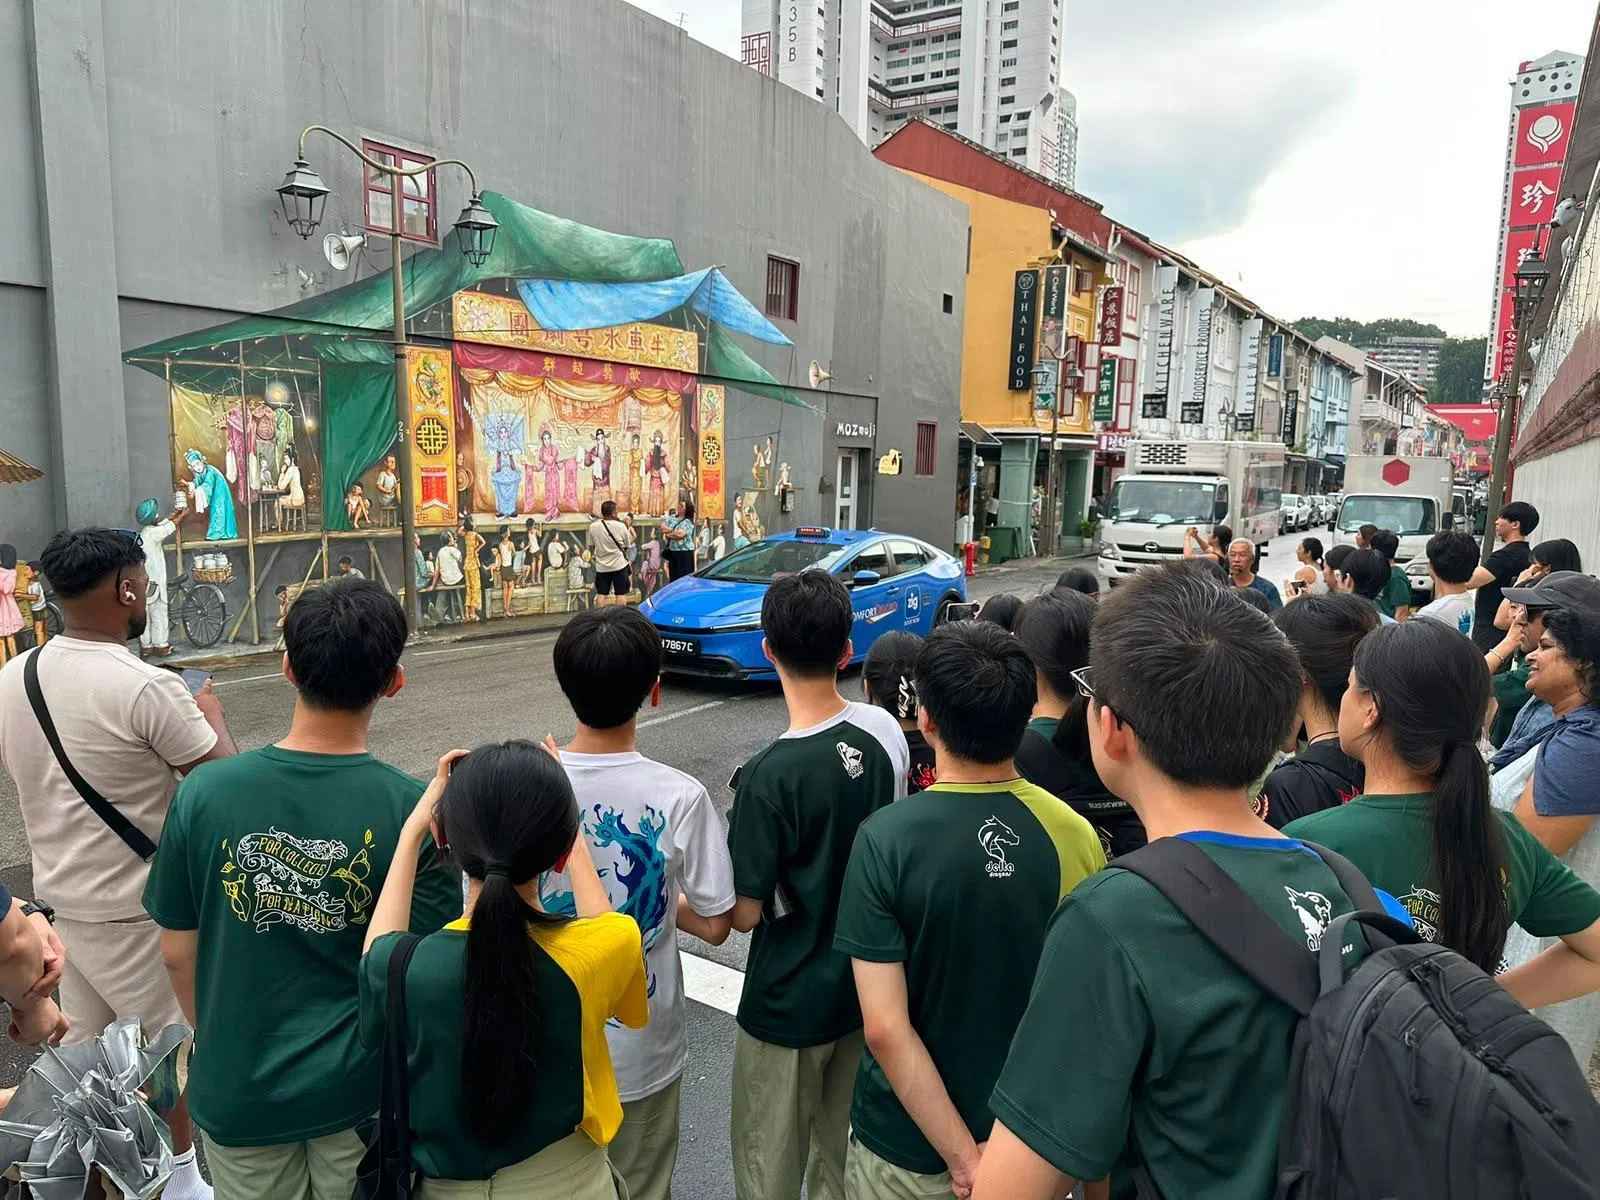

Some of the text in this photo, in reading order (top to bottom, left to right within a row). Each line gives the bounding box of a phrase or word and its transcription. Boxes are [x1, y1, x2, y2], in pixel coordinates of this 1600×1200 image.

[789, 0, 797, 62] 35B
[1020, 290, 1030, 336] THAI
[1197, 306, 1213, 348] PRODUCTS
[1154, 287, 1176, 394] KITCHENWARE
[1015, 342, 1026, 389] FOOD
[1192, 350, 1209, 401] FOODSERVICE
[1244, 335, 1260, 412] TABLEWARE
[398, 420, 404, 442] 23
[907, 592, 919, 610] zig
[258, 836, 328, 877] FOR COLLEGE
[985, 860, 1015, 872] delta
[259, 893, 332, 927] FOR NATION
[1407, 898, 1422, 915] FOR
